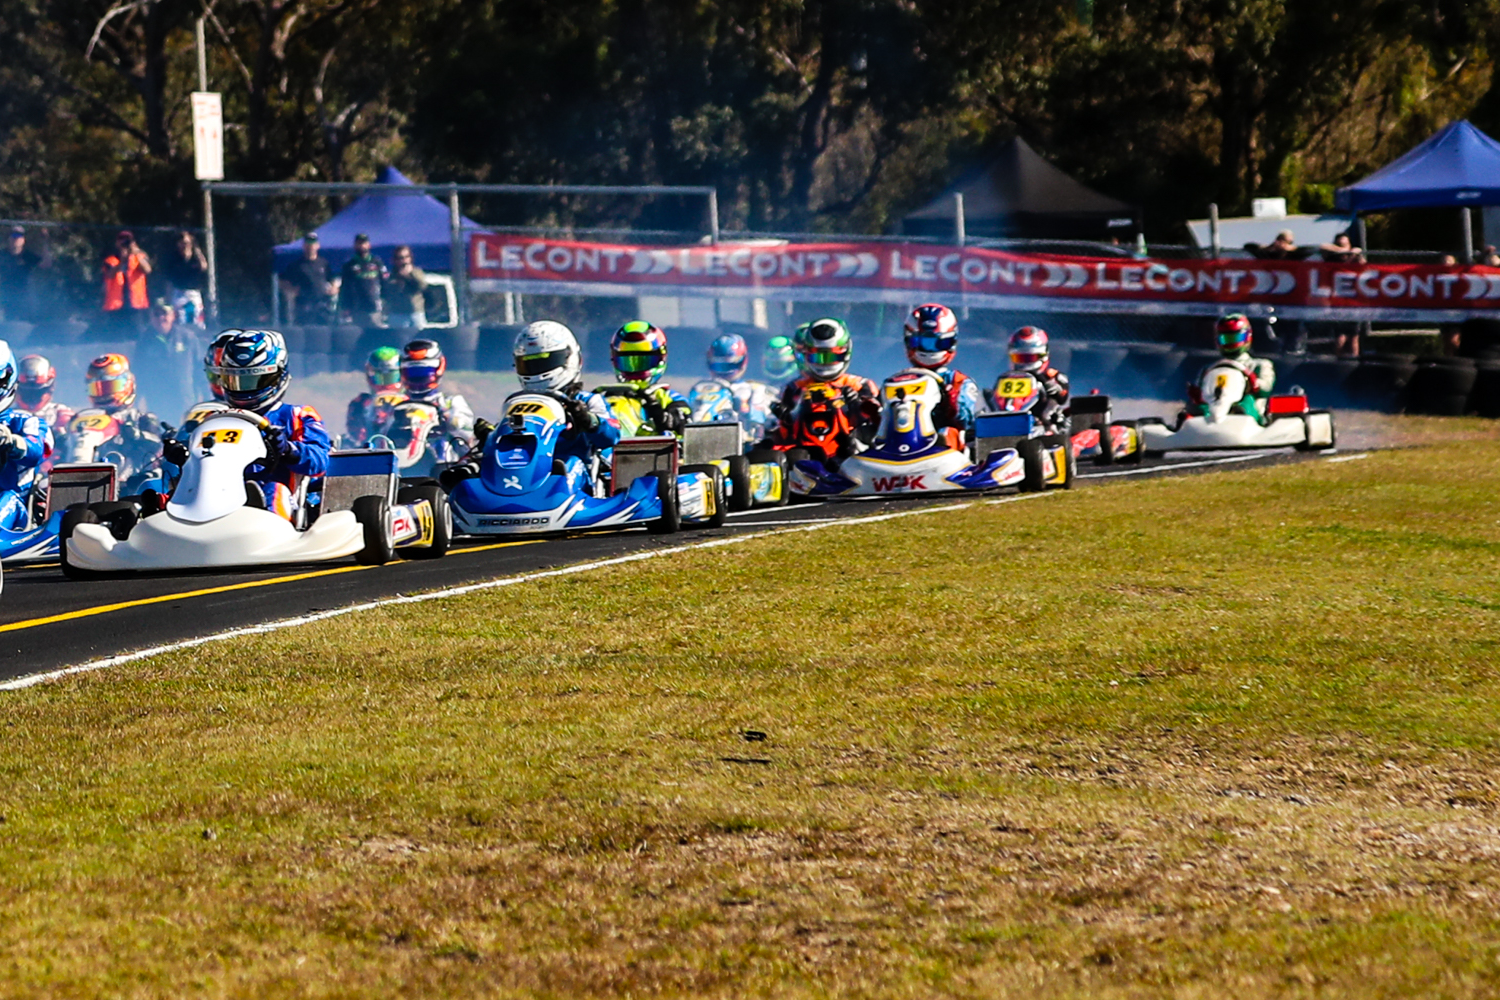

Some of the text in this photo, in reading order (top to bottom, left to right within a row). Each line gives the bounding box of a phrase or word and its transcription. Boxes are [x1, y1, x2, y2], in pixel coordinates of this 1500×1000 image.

[1003, 381, 1025, 394] 82
[508, 403, 543, 415] 60
[872, 475, 927, 492] WPK
[478, 517, 550, 527] RICCIARDO
